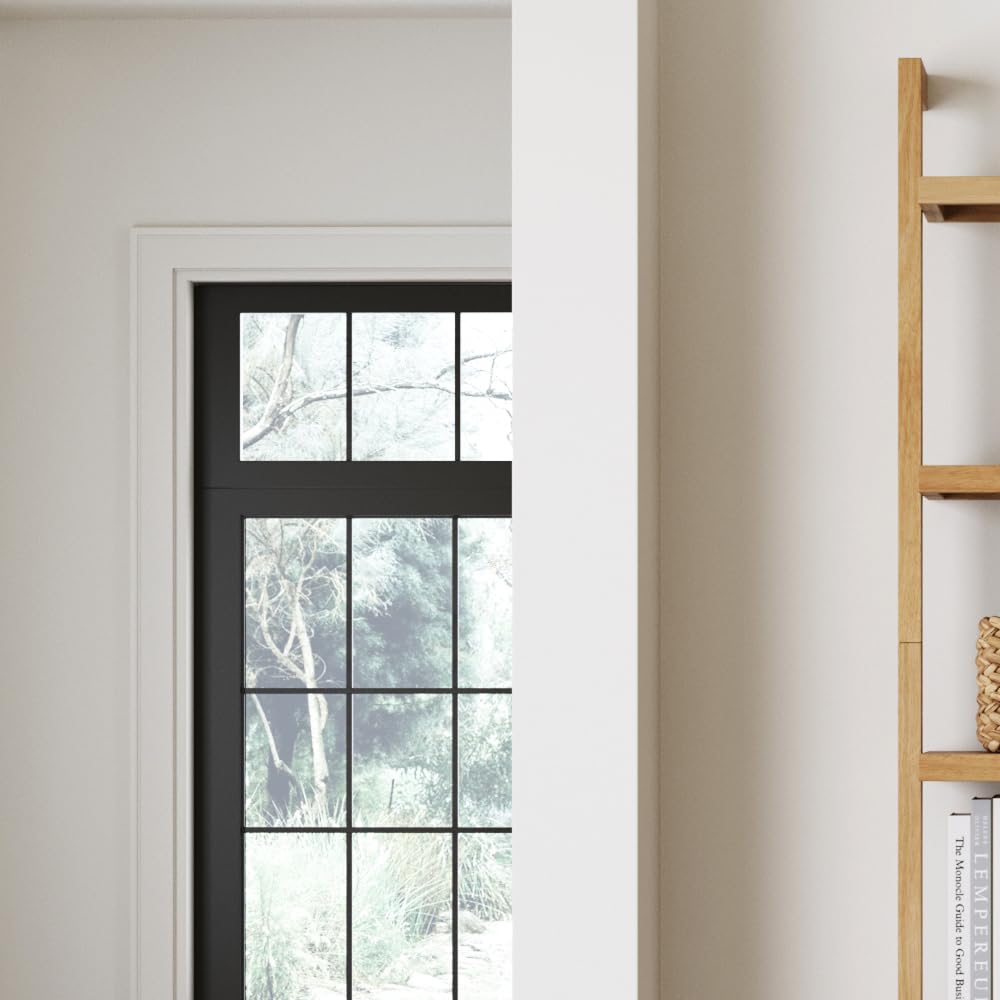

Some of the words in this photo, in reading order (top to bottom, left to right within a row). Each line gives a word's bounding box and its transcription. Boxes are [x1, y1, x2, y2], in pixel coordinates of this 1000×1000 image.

[955, 836, 965, 856] The
[955, 859, 965, 902] Monocle
[955, 903, 965, 934] Guide
[955, 936, 962, 946] to
[955, 948, 965, 976] Good
